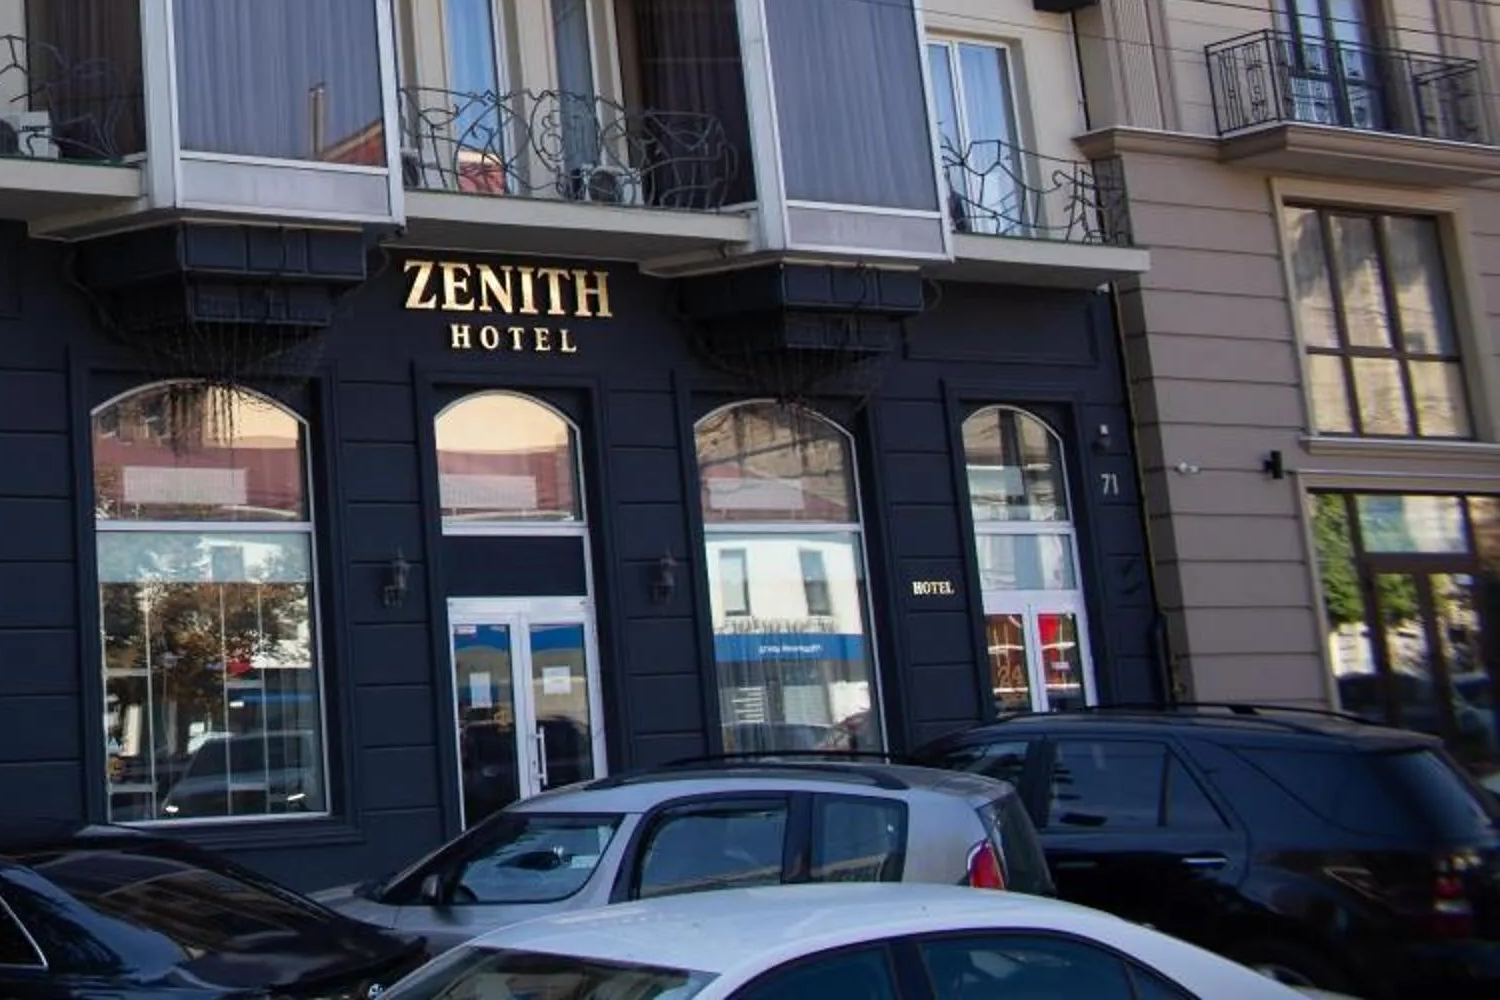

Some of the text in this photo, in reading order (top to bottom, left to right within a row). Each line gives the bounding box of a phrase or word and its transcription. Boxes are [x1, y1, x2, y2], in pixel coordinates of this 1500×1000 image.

[404, 259, 613, 318] ZENITH
[451, 323, 577, 353] HOTEL
[1100, 473, 1119, 496] 71
[912, 581, 955, 595] HOTEL
